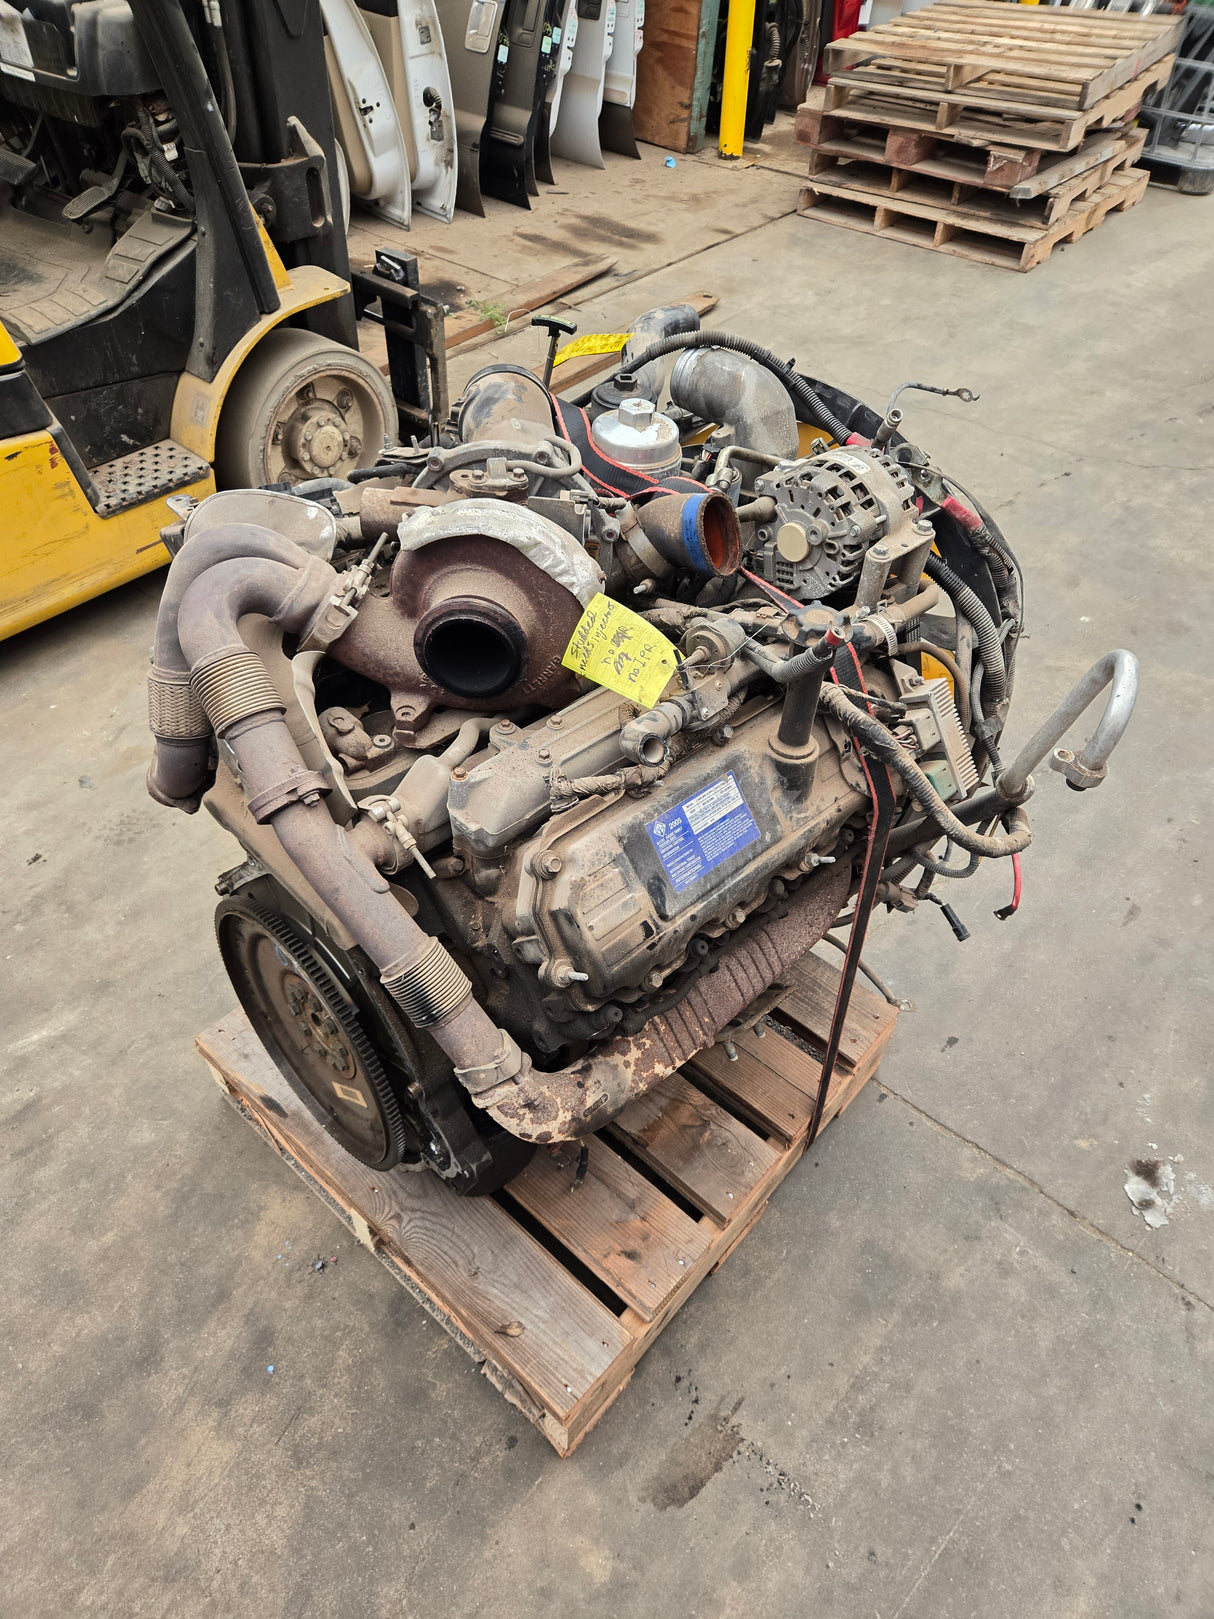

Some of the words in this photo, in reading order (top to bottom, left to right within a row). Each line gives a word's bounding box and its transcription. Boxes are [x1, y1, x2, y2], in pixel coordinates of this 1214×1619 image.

[522, 655, 562, 695] GARRETT
[628, 668, 640, 683] no
[669, 816, 682, 830] 2005
